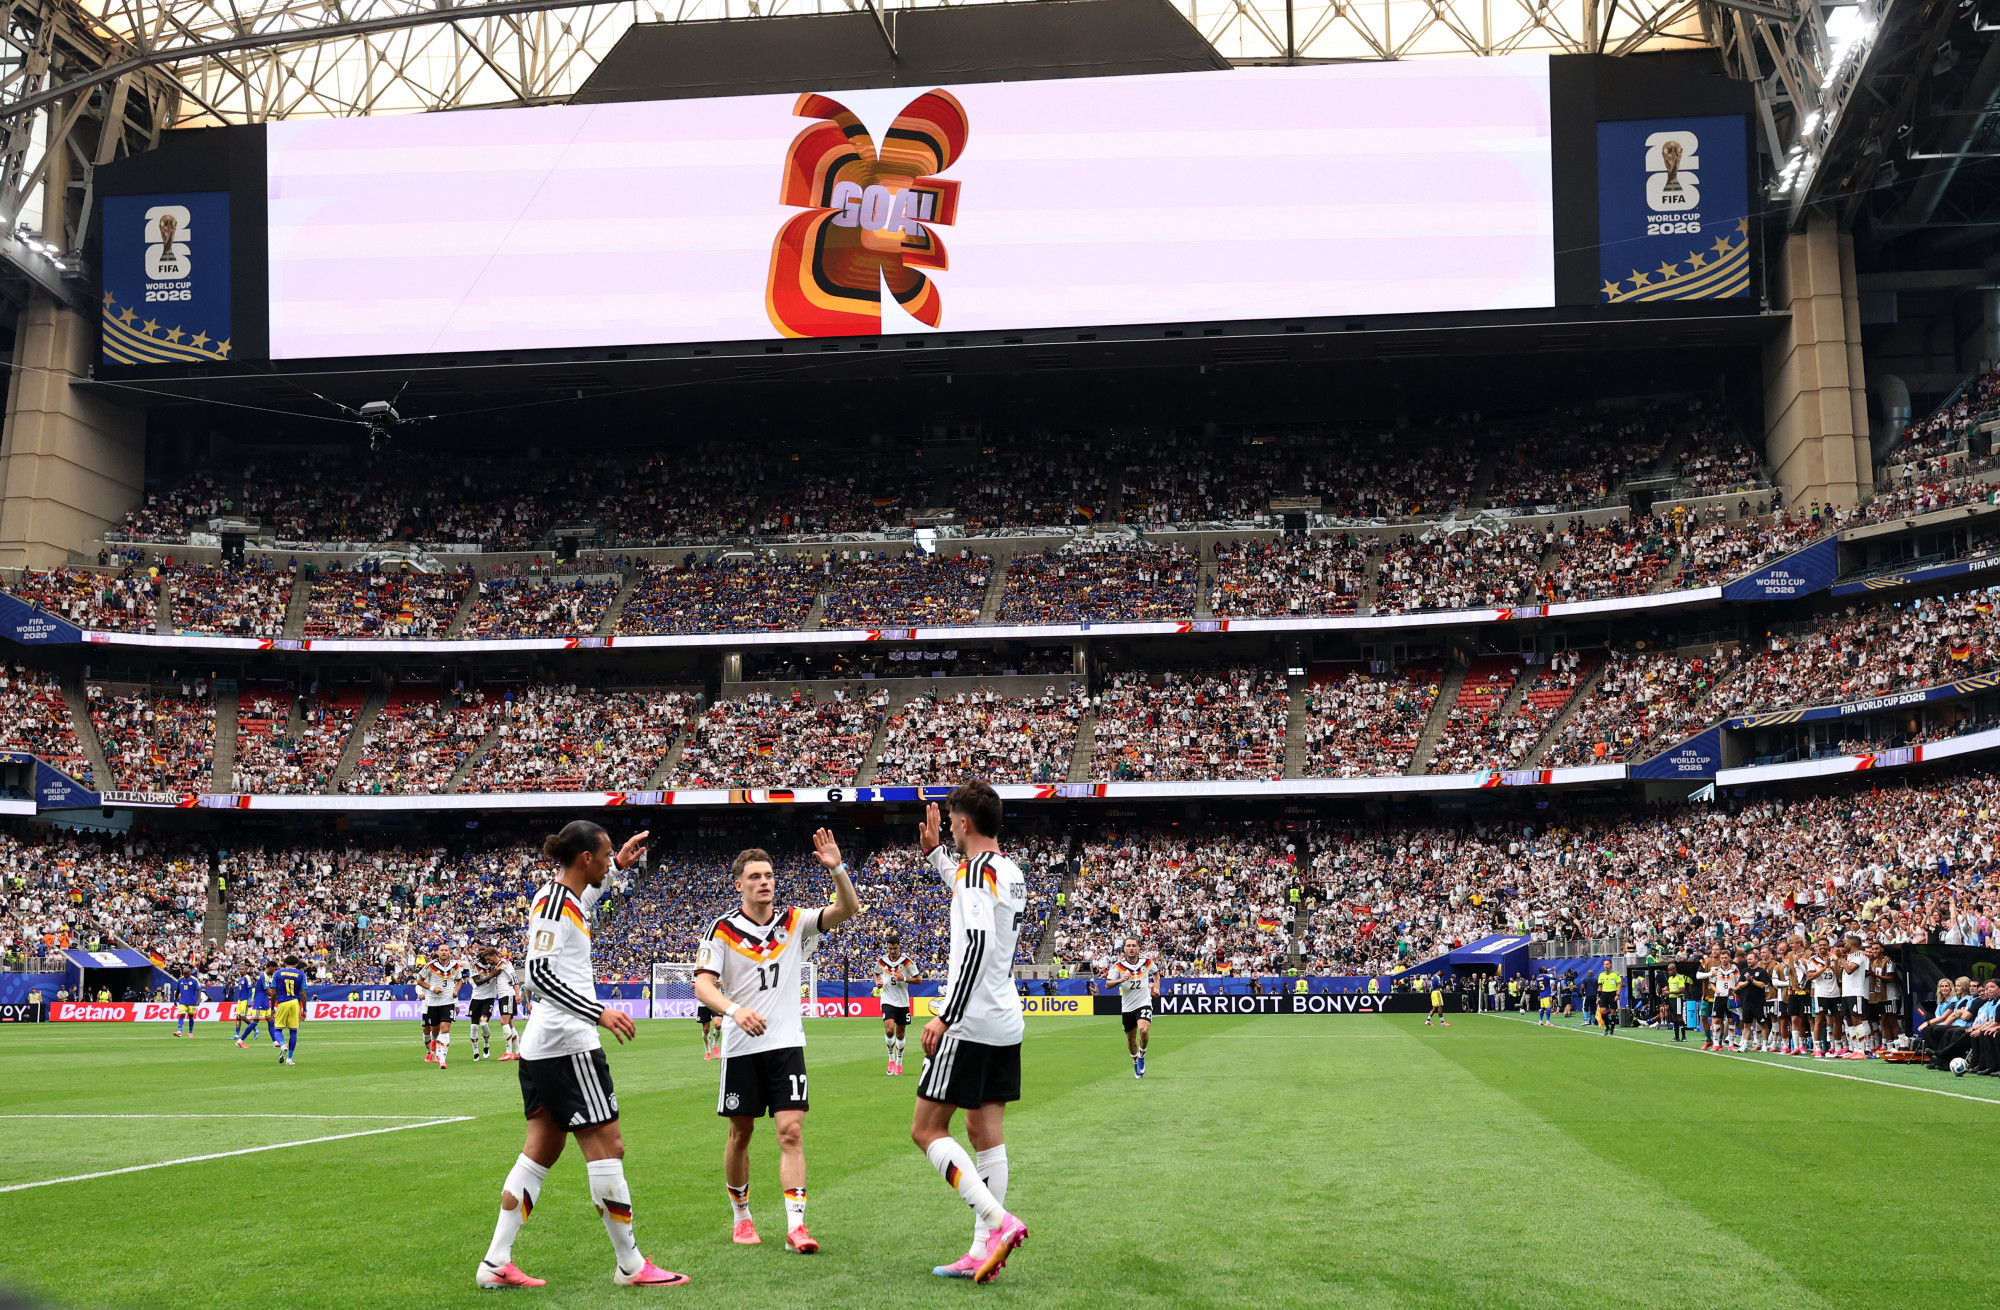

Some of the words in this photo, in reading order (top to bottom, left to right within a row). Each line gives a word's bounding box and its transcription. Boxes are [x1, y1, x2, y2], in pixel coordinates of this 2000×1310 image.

[1662, 195, 1686, 204] FIFA
[1647, 214, 1680, 222] WORLD
[1682, 213, 1700, 221] CUP
[1647, 222, 1701, 236] 2026
[158, 265, 179, 273] FIFA
[145, 282, 174, 290] WORLD
[145, 290, 192, 302] 2026
[1969, 560, 1987, 571] FIFA
[1840, 705, 1856, 715] FIFA
[1856, 700, 1883, 711] WORLD
[1883, 696, 1898, 707] CUP
[1899, 692, 1926, 705] 2026
[827, 789, 843, 802] 6
[871, 788, 884, 801] 1
[757, 963, 779, 991] 17
[1823, 972, 1833, 980] 23
[1130, 981, 1141, 990] 22
[1174, 983, 1206, 994] FIFA
[1539, 981, 1545, 991] 5
[363, 990, 391, 1000] FIFA
[503, 1005, 508, 1013] 8
[1042, 998, 1078, 1012] libre
[1160, 996, 1283, 1013] MARRIOTT
[1885, 1005, 1892, 1013] 10
[60, 1003, 125, 1020] Betano
[144, 1004, 210, 1020] Beto
[314, 1003, 381, 1019] Betano
[1141, 1009, 1151, 1018] 22
[906, 1013, 911, 1022] 5
[789, 1074, 807, 1101] 17
